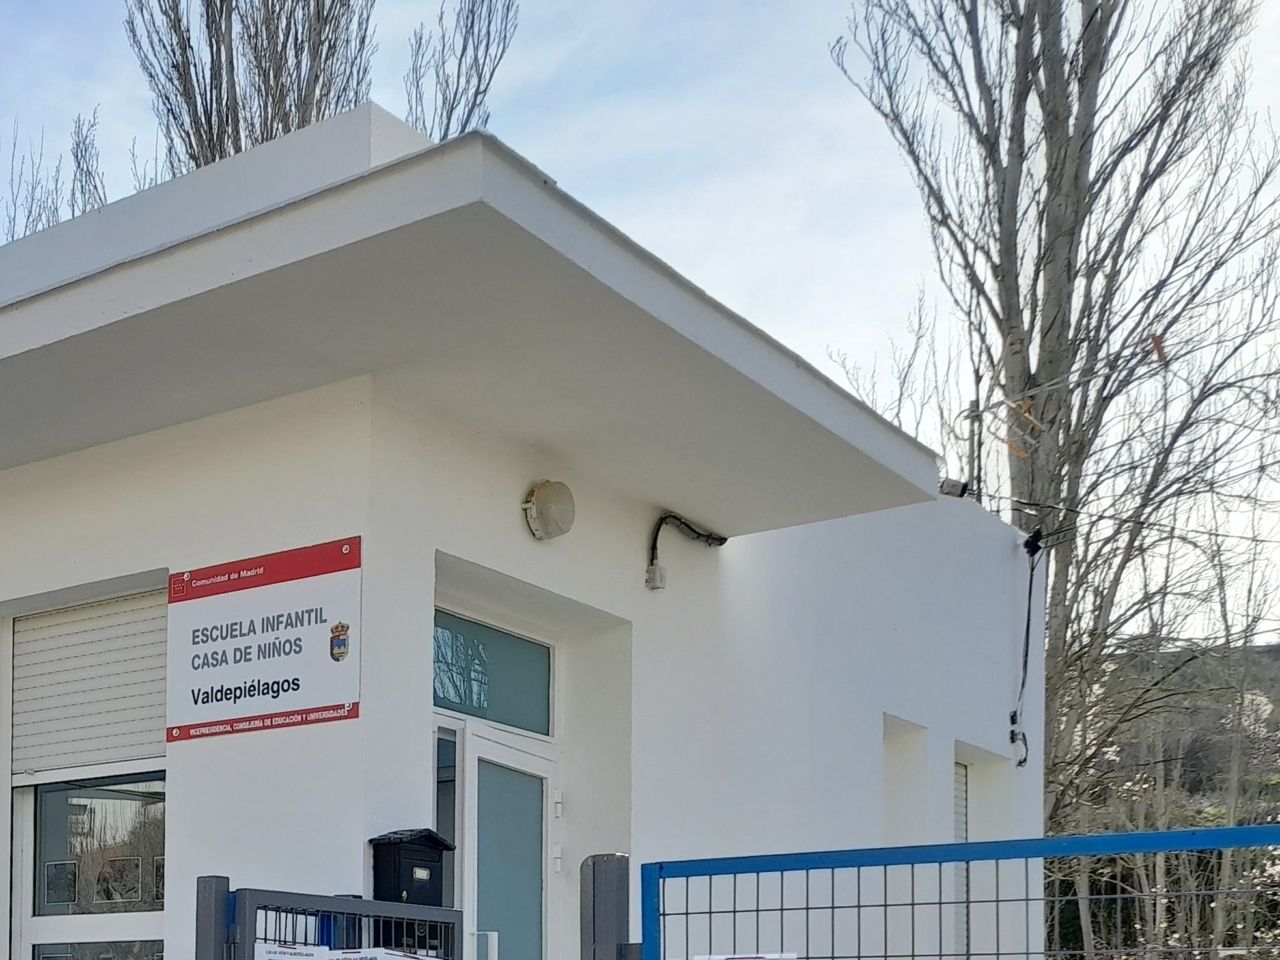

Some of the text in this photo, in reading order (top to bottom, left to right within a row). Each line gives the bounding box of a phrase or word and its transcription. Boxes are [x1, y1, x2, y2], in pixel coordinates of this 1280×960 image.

[191, 566, 264, 587] Comunidad de Madrid
[191, 606, 328, 646] ESCUELA INFANTIL
[191, 636, 303, 671] CASA DE NIÑOS
[191, 677, 301, 706] Valdepiélagos
[264, 717, 272, 727] DE
[272, 714, 302, 725] EDUCACIÓN
[306, 707, 348, 721] UNIVERSIDADES
